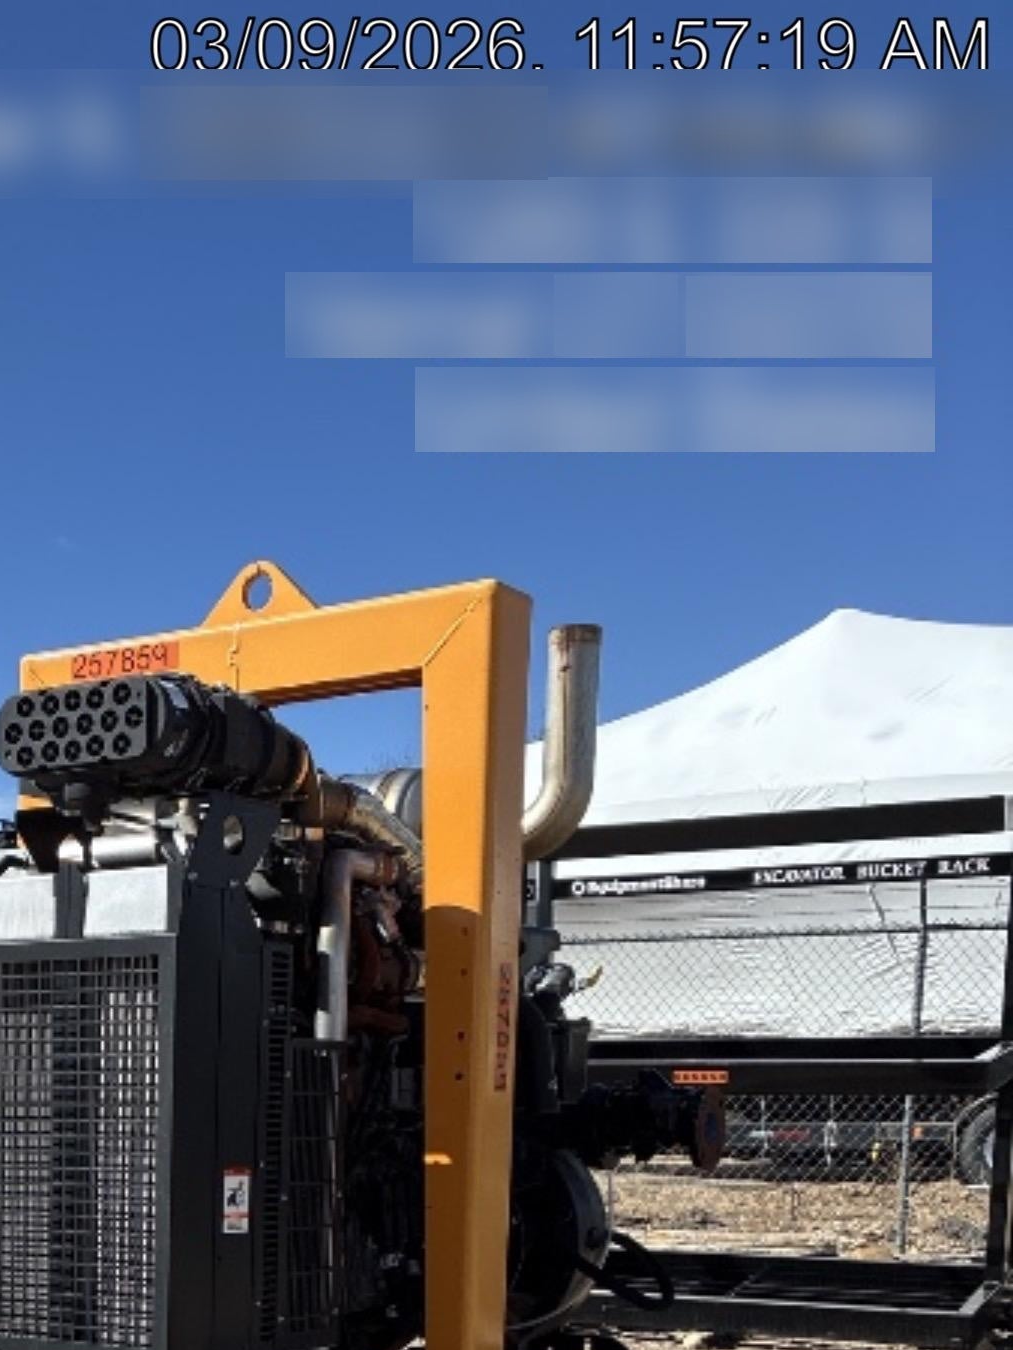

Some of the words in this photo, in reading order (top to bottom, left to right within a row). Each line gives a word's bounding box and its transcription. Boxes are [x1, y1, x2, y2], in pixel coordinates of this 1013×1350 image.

[73, 643, 168, 679] 257859
[857, 860, 927, 880] BUCKET
[938, 857, 991, 875] RACK
